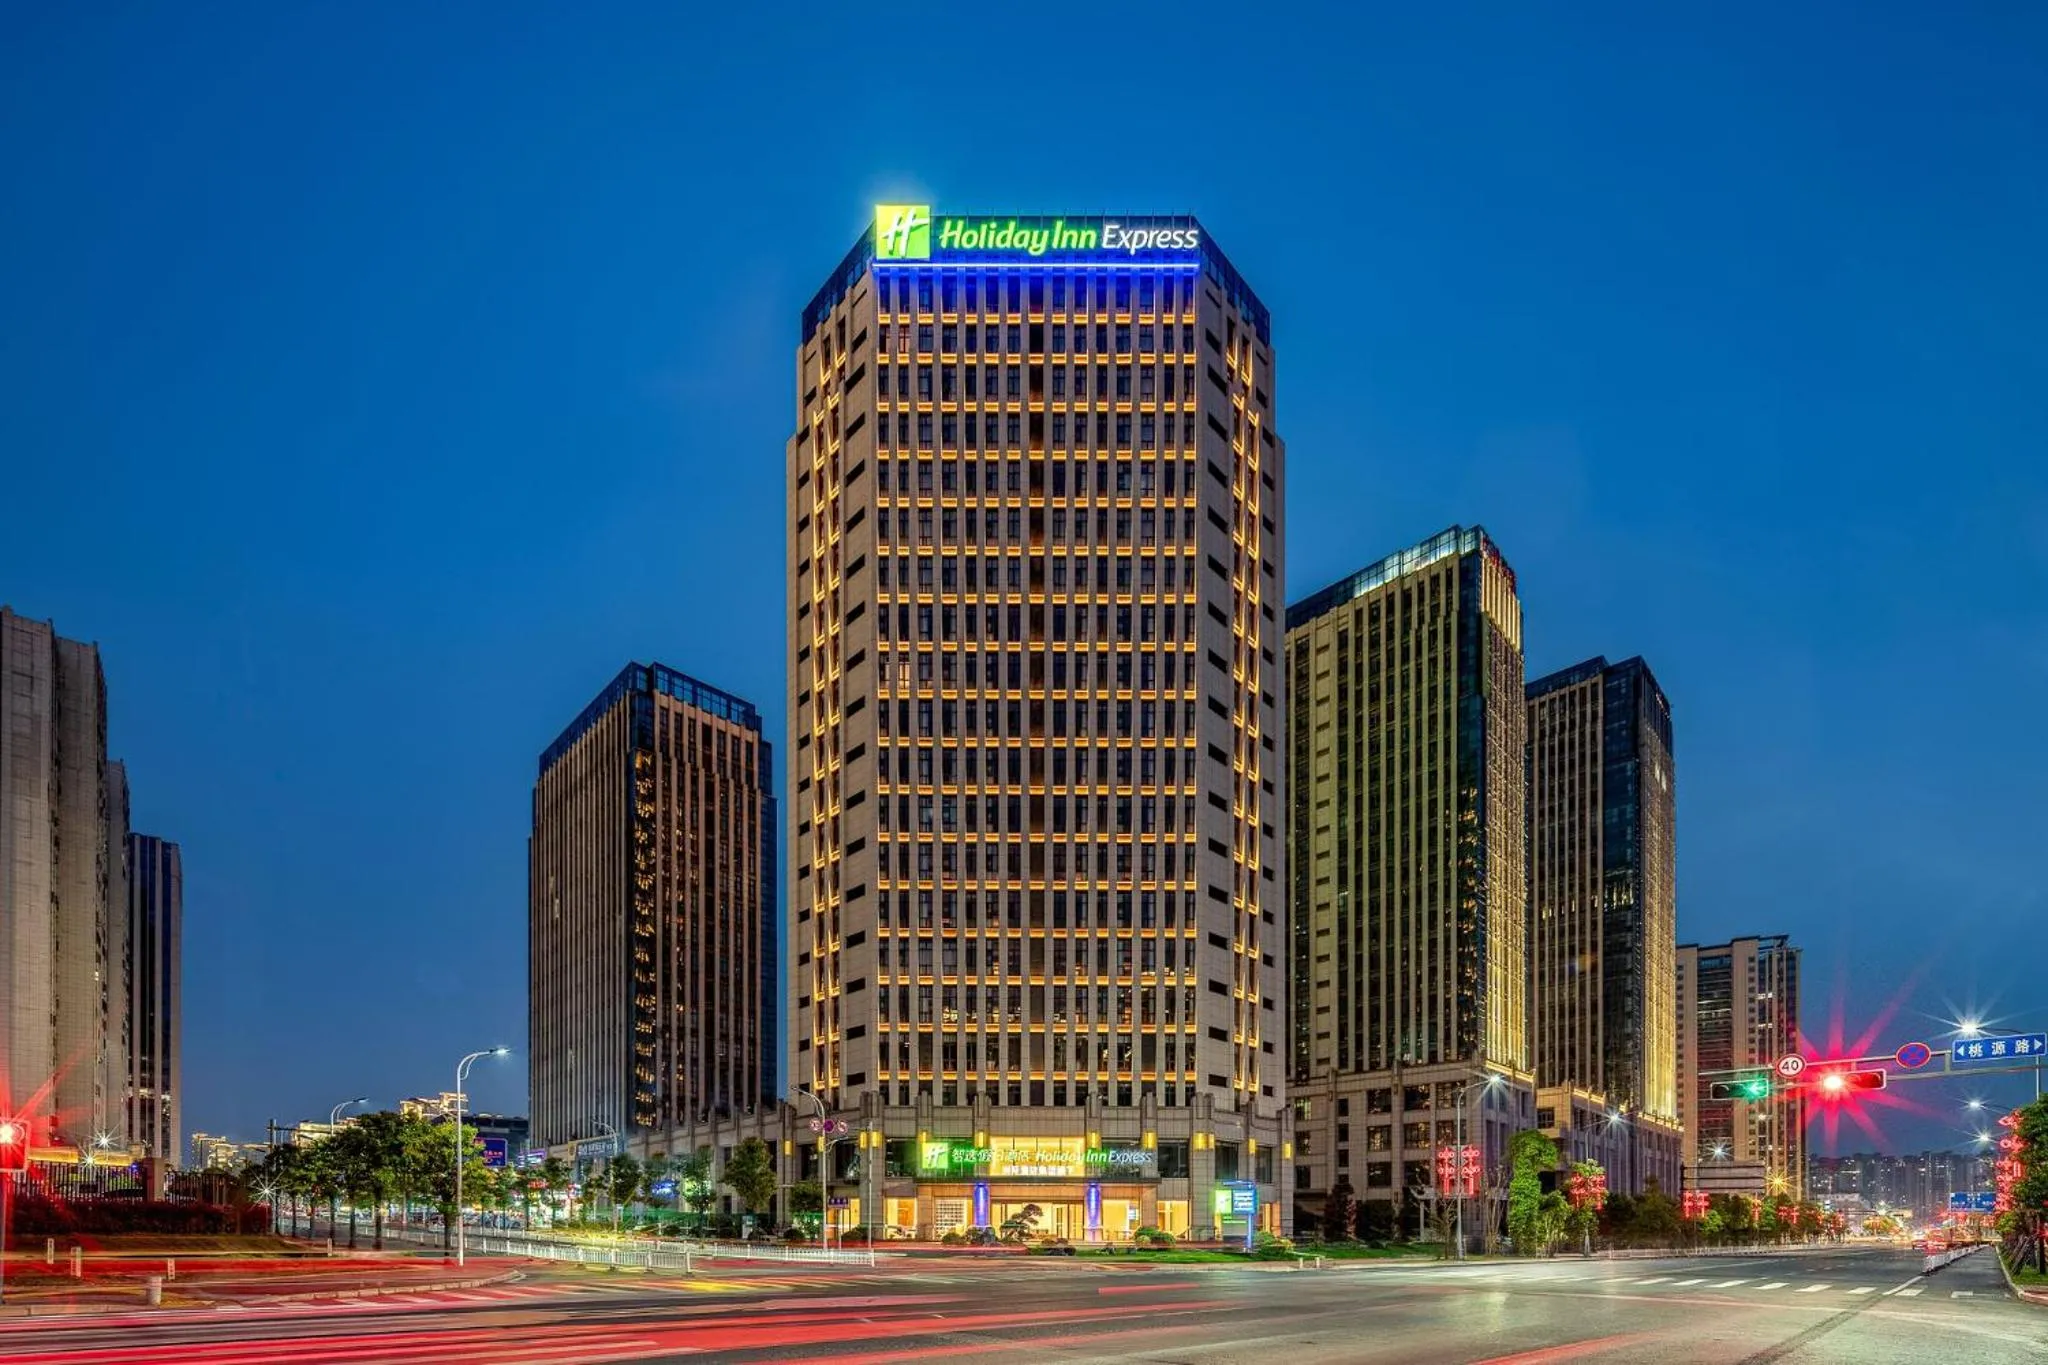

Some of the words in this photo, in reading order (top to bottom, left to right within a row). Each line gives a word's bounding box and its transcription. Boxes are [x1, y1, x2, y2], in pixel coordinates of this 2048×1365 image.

[939, 219, 1050, 256] Holiday
[1051, 219, 1098, 249] Inn
[1101, 223, 1199, 256] Express
[1968, 1038, 2030, 1058] 桃源路
[1781, 1060, 1799, 1071] 40
[1036, 1149, 1085, 1165] Holiday
[1085, 1148, 1107, 1163] Inn
[1108, 1149, 1153, 1166] Express
